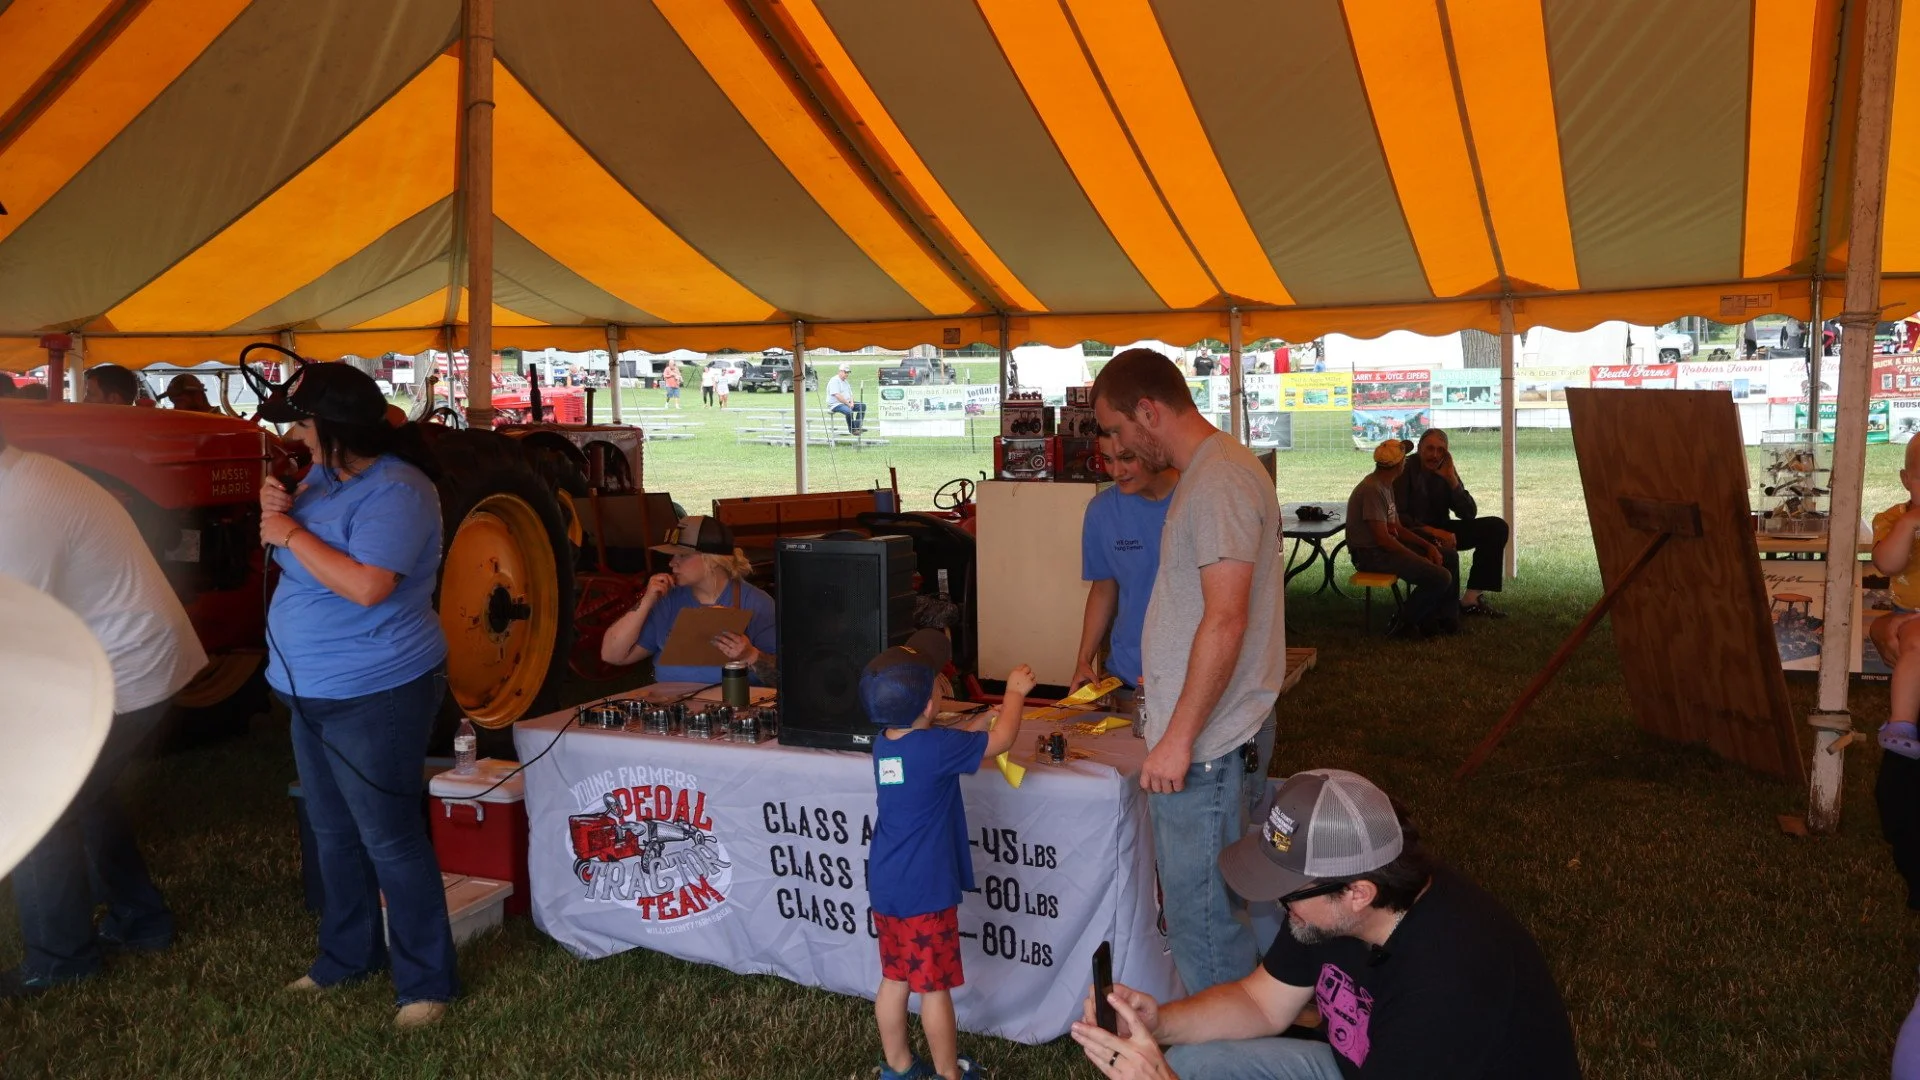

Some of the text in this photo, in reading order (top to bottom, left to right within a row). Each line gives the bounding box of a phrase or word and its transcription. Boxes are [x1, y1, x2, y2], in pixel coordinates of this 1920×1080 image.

[1353, 373, 1373, 381] LARRY
[1597, 365, 1672, 379] Beutel Farms
[1681, 363, 1763, 376] Robbins Farms
[212, 482, 251, 497] HARRIS
[569, 765, 698, 811] YOUNG FARMERS
[612, 784, 713, 832] PEDAL
[763, 801, 850, 846] CLASS
[584, 843, 731, 901] TRACTOR
[769, 844, 854, 890] CLASS
[637, 875, 726, 921] TEAM
[776, 887, 857, 935] CLASS
[664, 921, 695, 935] COUNTY
